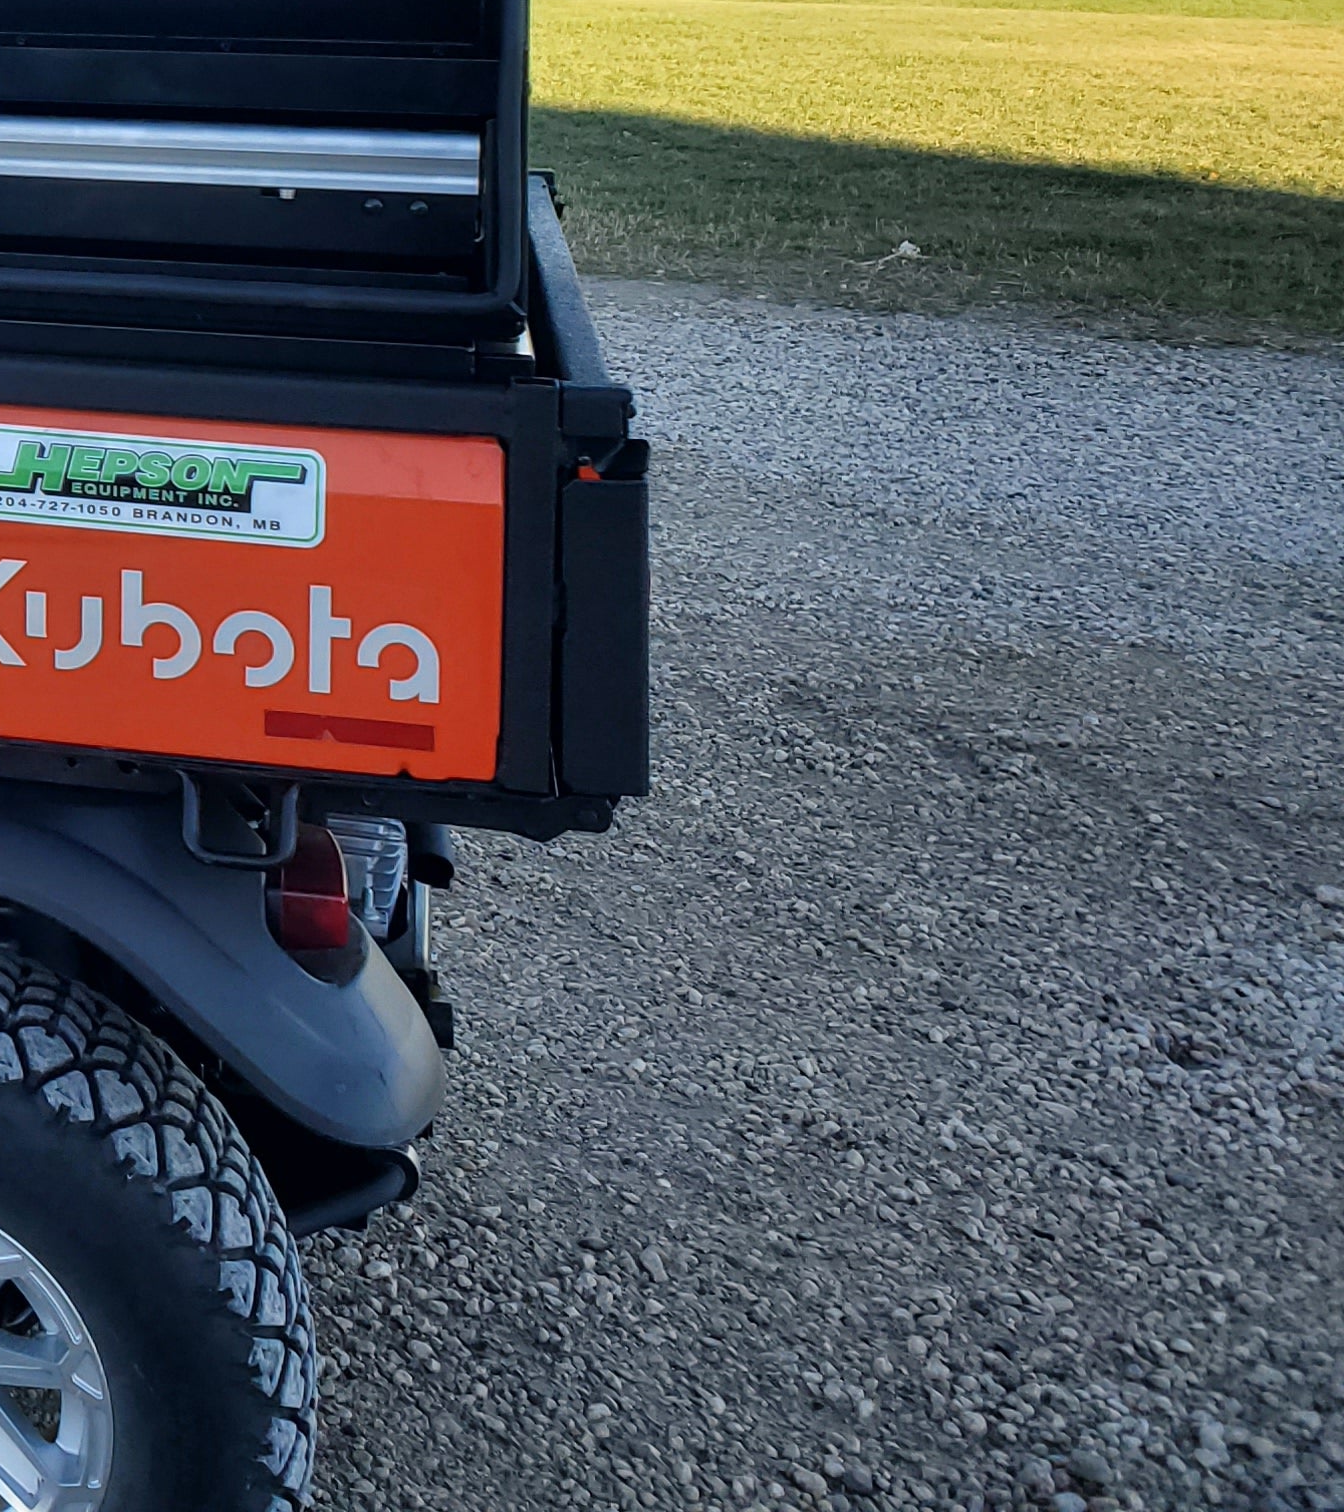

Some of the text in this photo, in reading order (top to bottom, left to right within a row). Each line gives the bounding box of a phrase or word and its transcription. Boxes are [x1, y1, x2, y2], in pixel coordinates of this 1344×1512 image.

[70, 482, 240, 508] EQUIPMENT INC.
[132, 507, 241, 530] BRANDON,
[252, 518, 282, 532] MB
